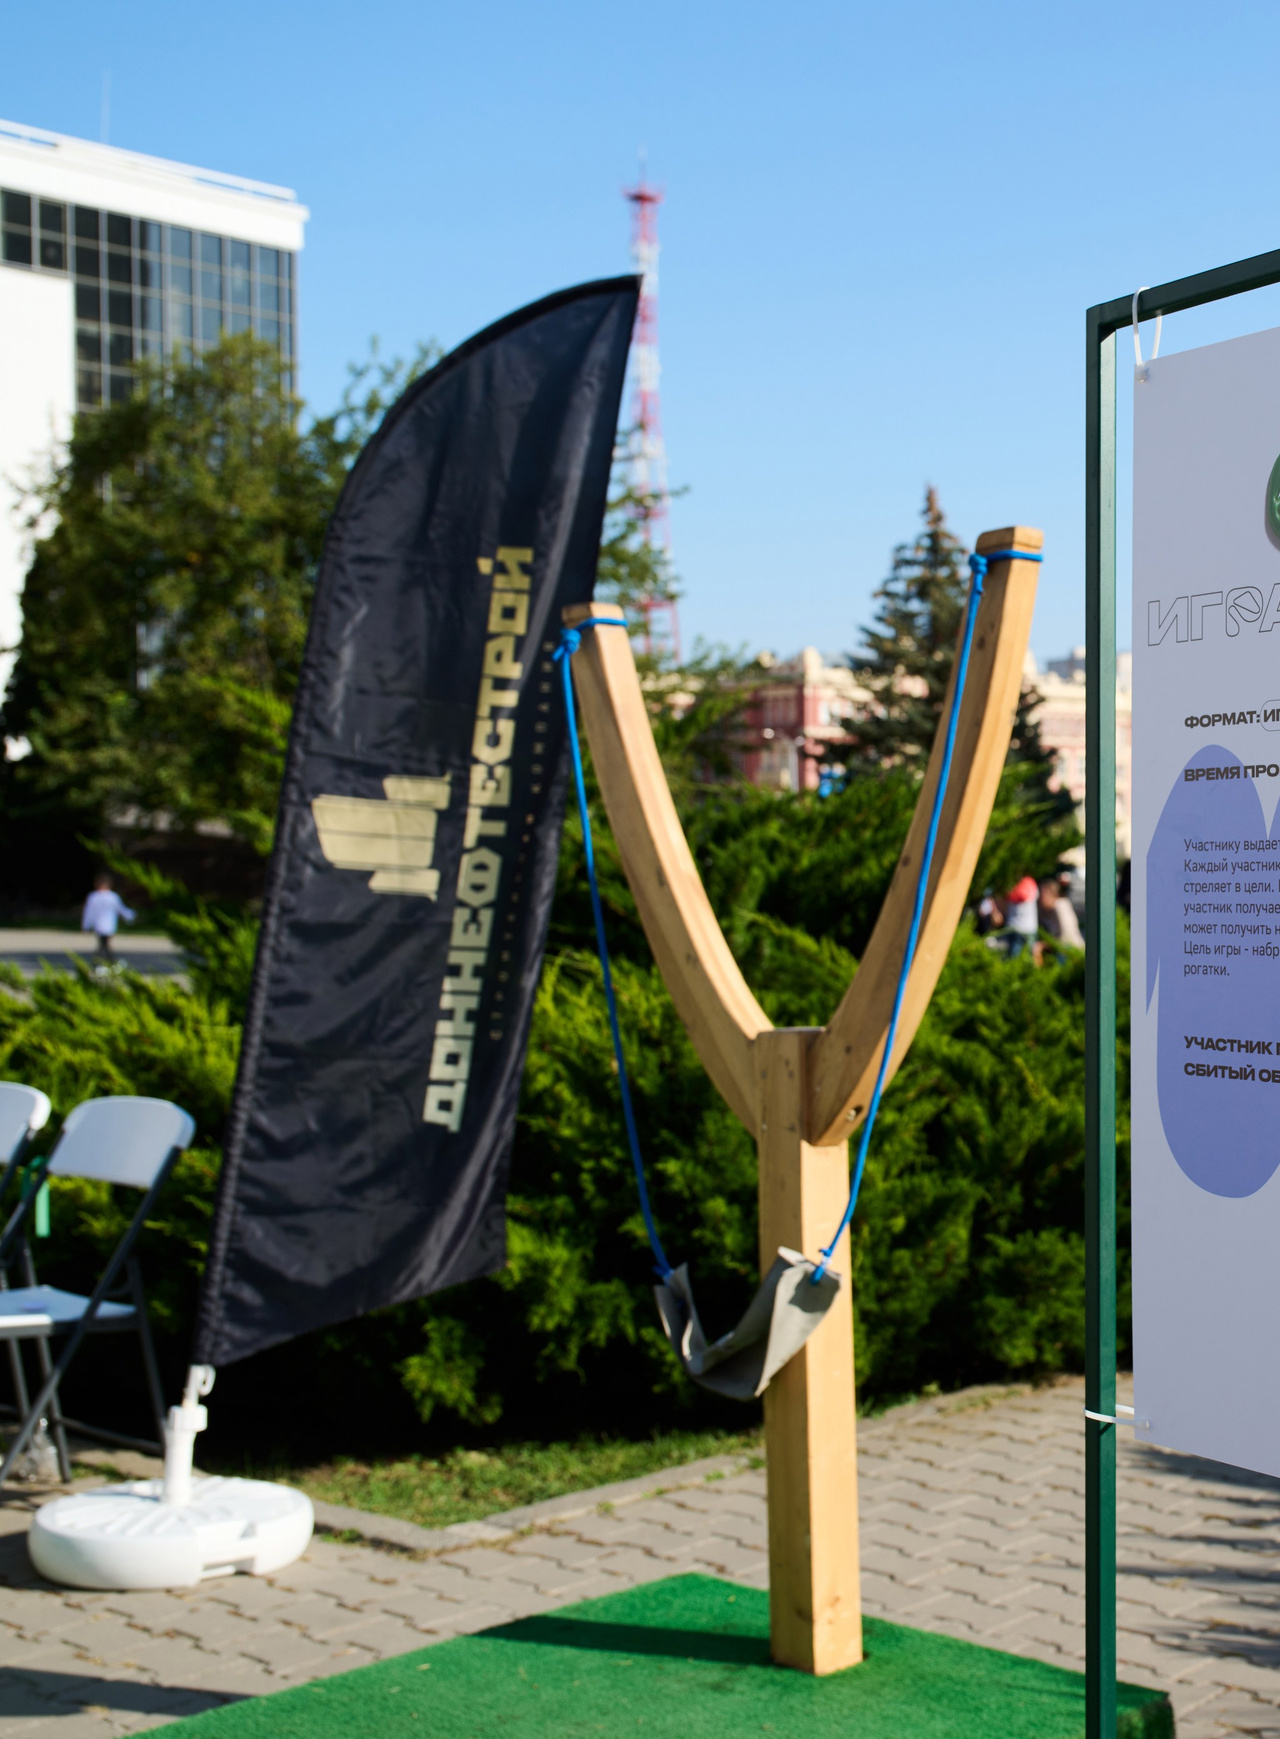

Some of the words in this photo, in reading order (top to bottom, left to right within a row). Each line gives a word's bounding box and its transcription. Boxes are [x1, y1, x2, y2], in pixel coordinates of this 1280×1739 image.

[1184, 711, 1261, 728] ФОРМАТ:
[1184, 766, 1240, 782] ВРЕМЯ
[423, 546, 534, 1133] ДОННЕФТЕСТРОЙ
[1184, 839, 1240, 853] Участнику
[1184, 858, 1228, 874] Каждый
[1183, 882, 1232, 895] стреляет
[1235, 882, 1241, 892] в
[1244, 882, 1275, 894] цели.
[1183, 902, 1233, 916] участник
[1183, 923, 1218, 934] может
[1220, 923, 1272, 937] получить
[1183, 940, 1211, 956] Цель
[1214, 944, 1241, 958] игры
[1183, 963, 1230, 977] рогатки.
[1184, 1035, 1273, 1056] УЧАСТНИК
[1184, 1062, 1256, 1082] СБИТЫЙ
